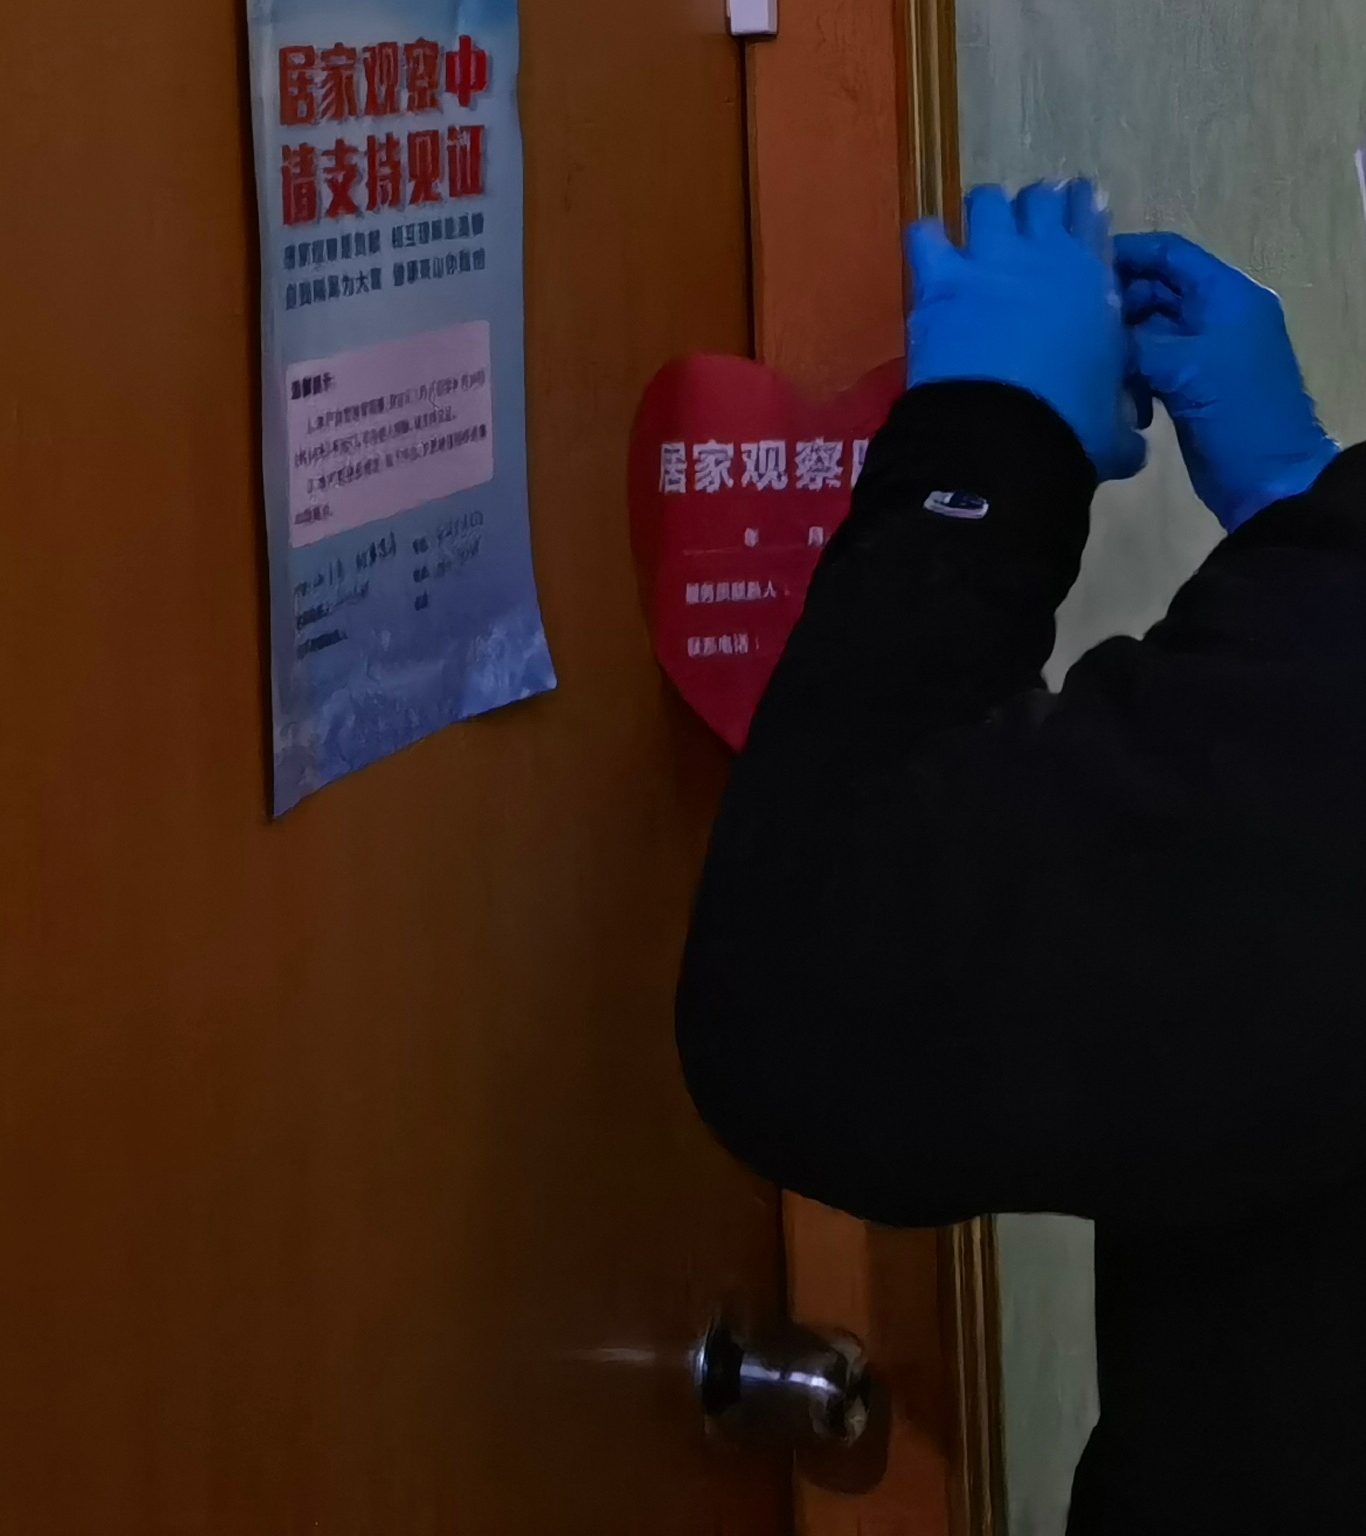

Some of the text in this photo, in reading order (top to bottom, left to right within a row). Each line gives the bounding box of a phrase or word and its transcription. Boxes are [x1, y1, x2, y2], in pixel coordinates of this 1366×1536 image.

[279, 35, 488, 125] 居家观察中
[281, 124, 485, 226] 请支持见证
